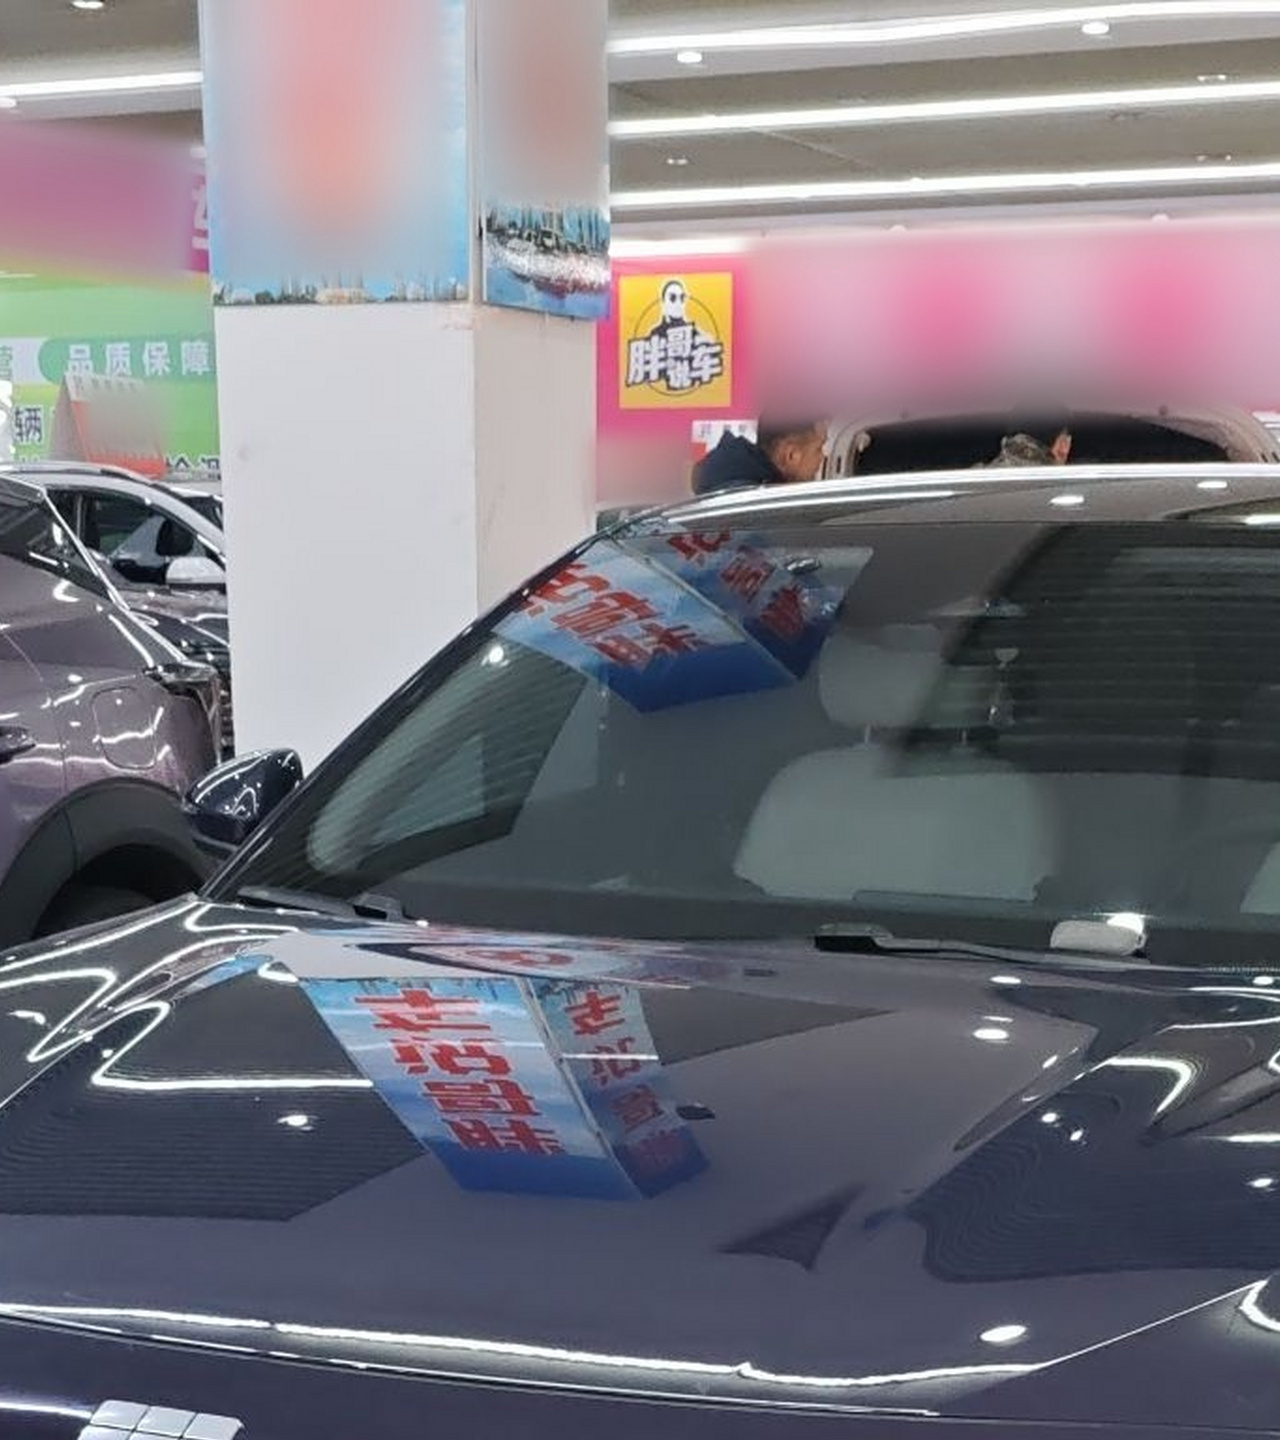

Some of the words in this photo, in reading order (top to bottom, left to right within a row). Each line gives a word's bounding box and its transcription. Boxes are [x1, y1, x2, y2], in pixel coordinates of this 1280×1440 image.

[67, 341, 216, 376] 品质保障
[626, 323, 724, 391] 胖哥说车
